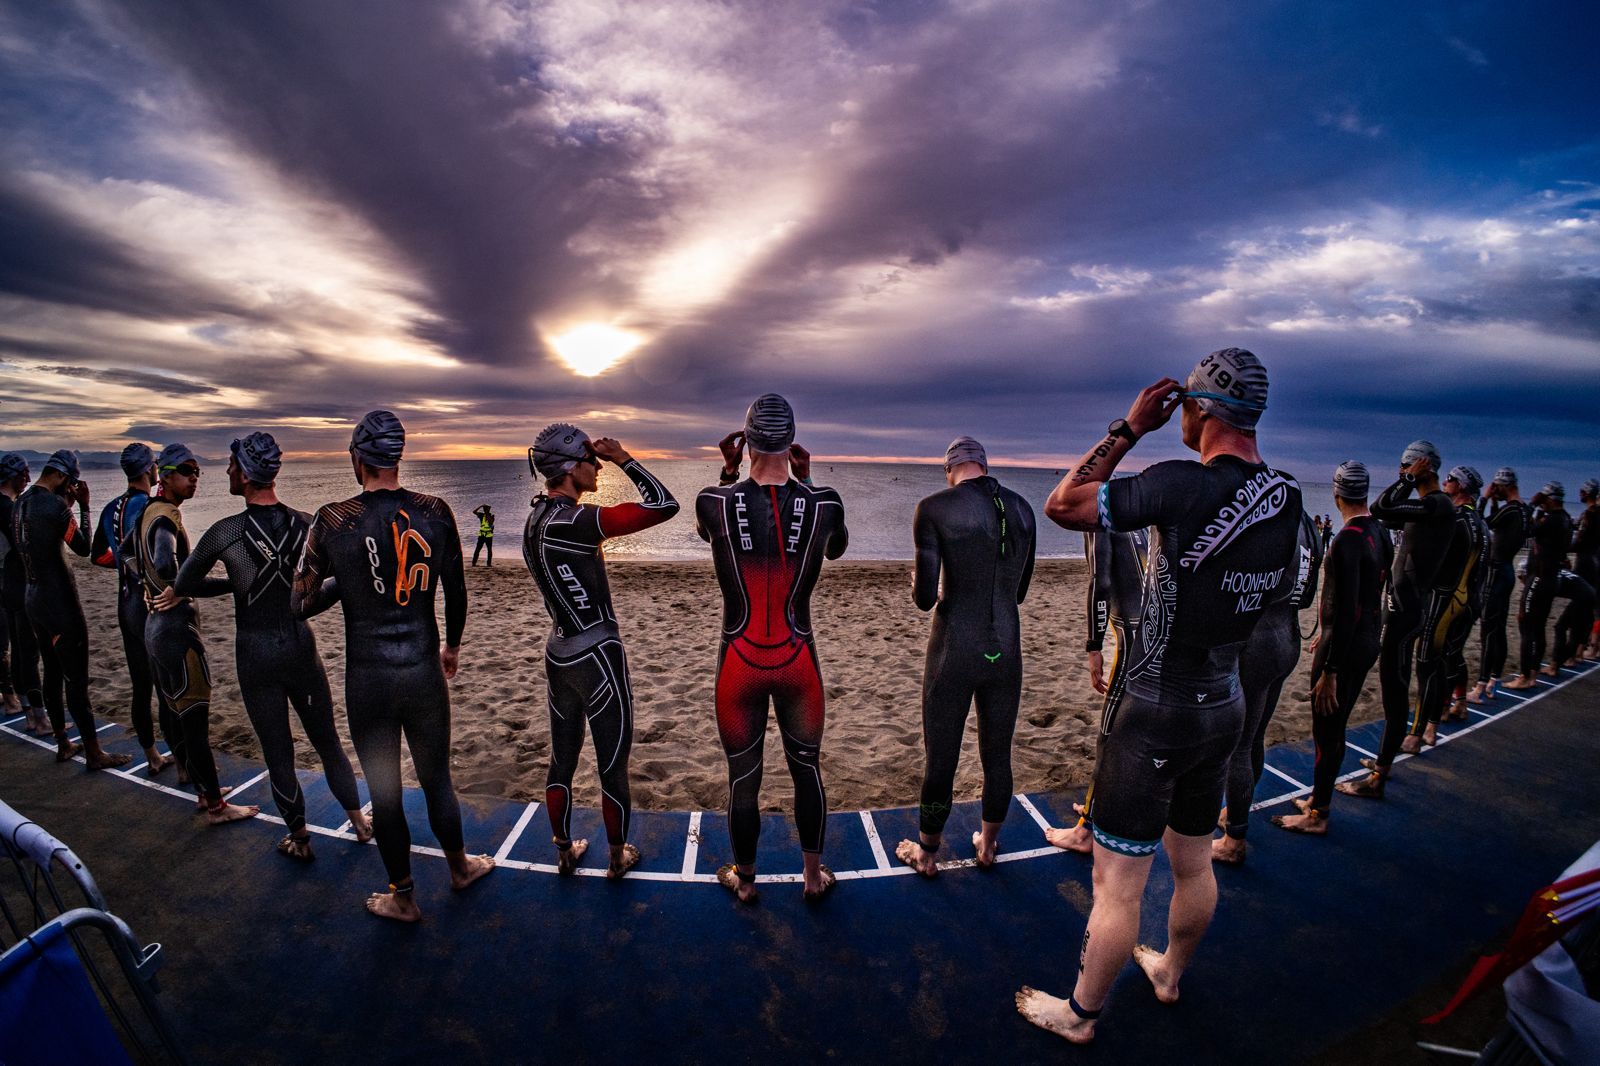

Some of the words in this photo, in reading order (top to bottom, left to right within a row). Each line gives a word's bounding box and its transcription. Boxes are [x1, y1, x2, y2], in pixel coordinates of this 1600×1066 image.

[1201, 354, 1248, 400] 3195
[243, 438, 269, 470] 3225
[734, 492, 753, 551] HUUB
[786, 497, 806, 553] HUUB
[256, 539, 277, 561] 2XU
[365, 536, 386, 594] orca
[556, 563, 591, 610] HUUB
[1220, 567, 1286, 593] HOONHOUT
[1097, 600, 1107, 632] HUUB
[1234, 592, 1263, 615] NZL
